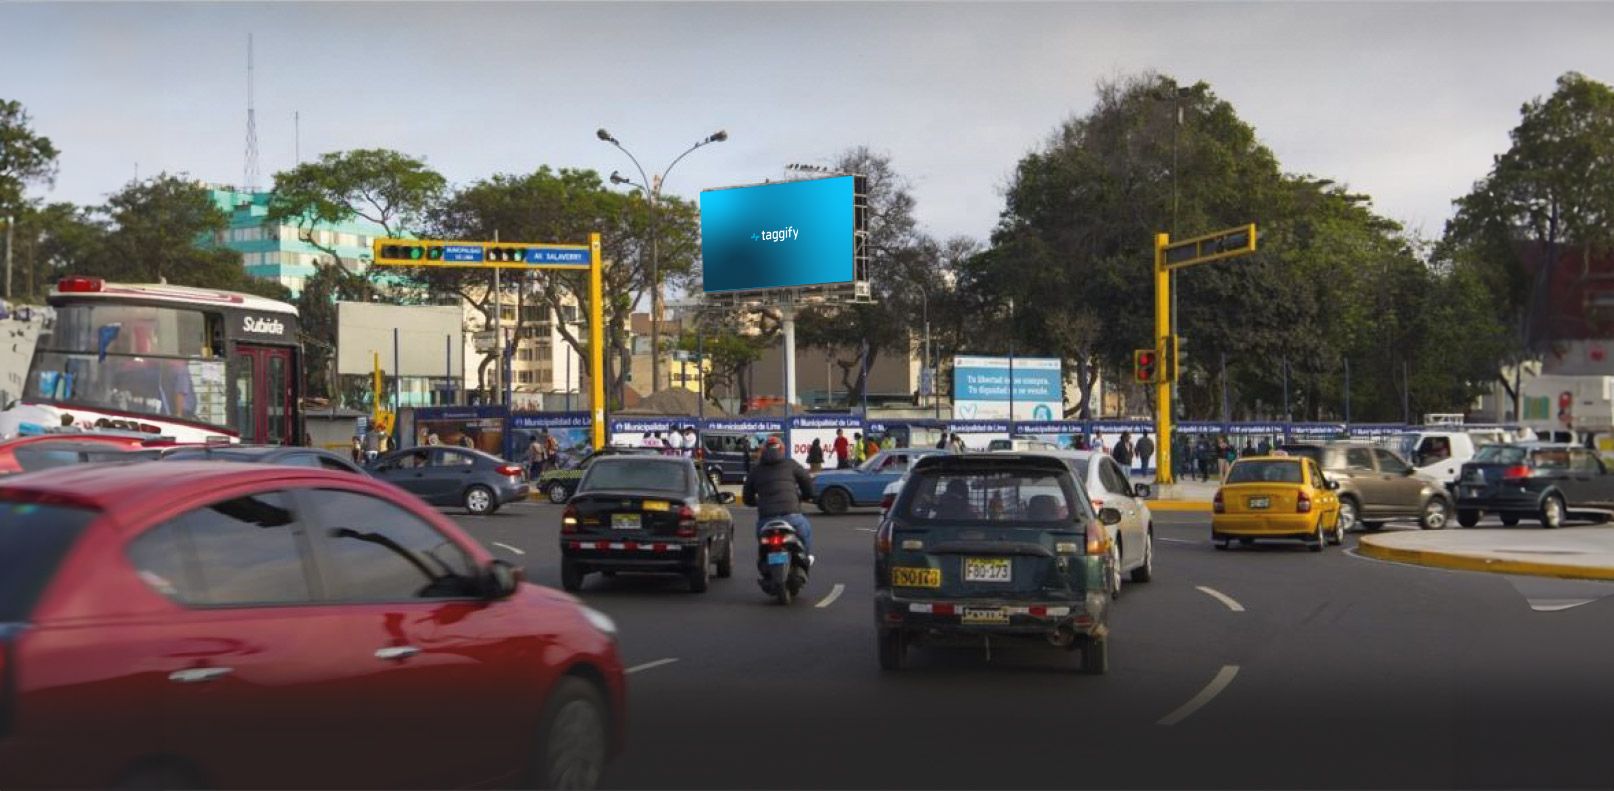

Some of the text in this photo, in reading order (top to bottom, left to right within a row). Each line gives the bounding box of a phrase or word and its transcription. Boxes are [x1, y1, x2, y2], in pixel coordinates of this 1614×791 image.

[761, 226, 799, 242] taggify
[546, 252, 582, 261] SALAVERRY
[243, 316, 285, 335] Subida
[967, 375, 976, 384] Tu
[977, 374, 1003, 384] libertad
[967, 386, 977, 394] Tu
[979, 385, 1006, 395] dignidad
[524, 416, 571, 426] Municipalidad
[573, 416, 581, 425] de
[716, 421, 781, 431] Municipalidad de Lima
[800, 418, 837, 427] Municipalidad
[624, 422, 669, 432] Municipalidad
[950, 424, 985, 433] Municipalidad
[993, 424, 1007, 432] Lima
[1025, 425, 1060, 434] Municipalidad
